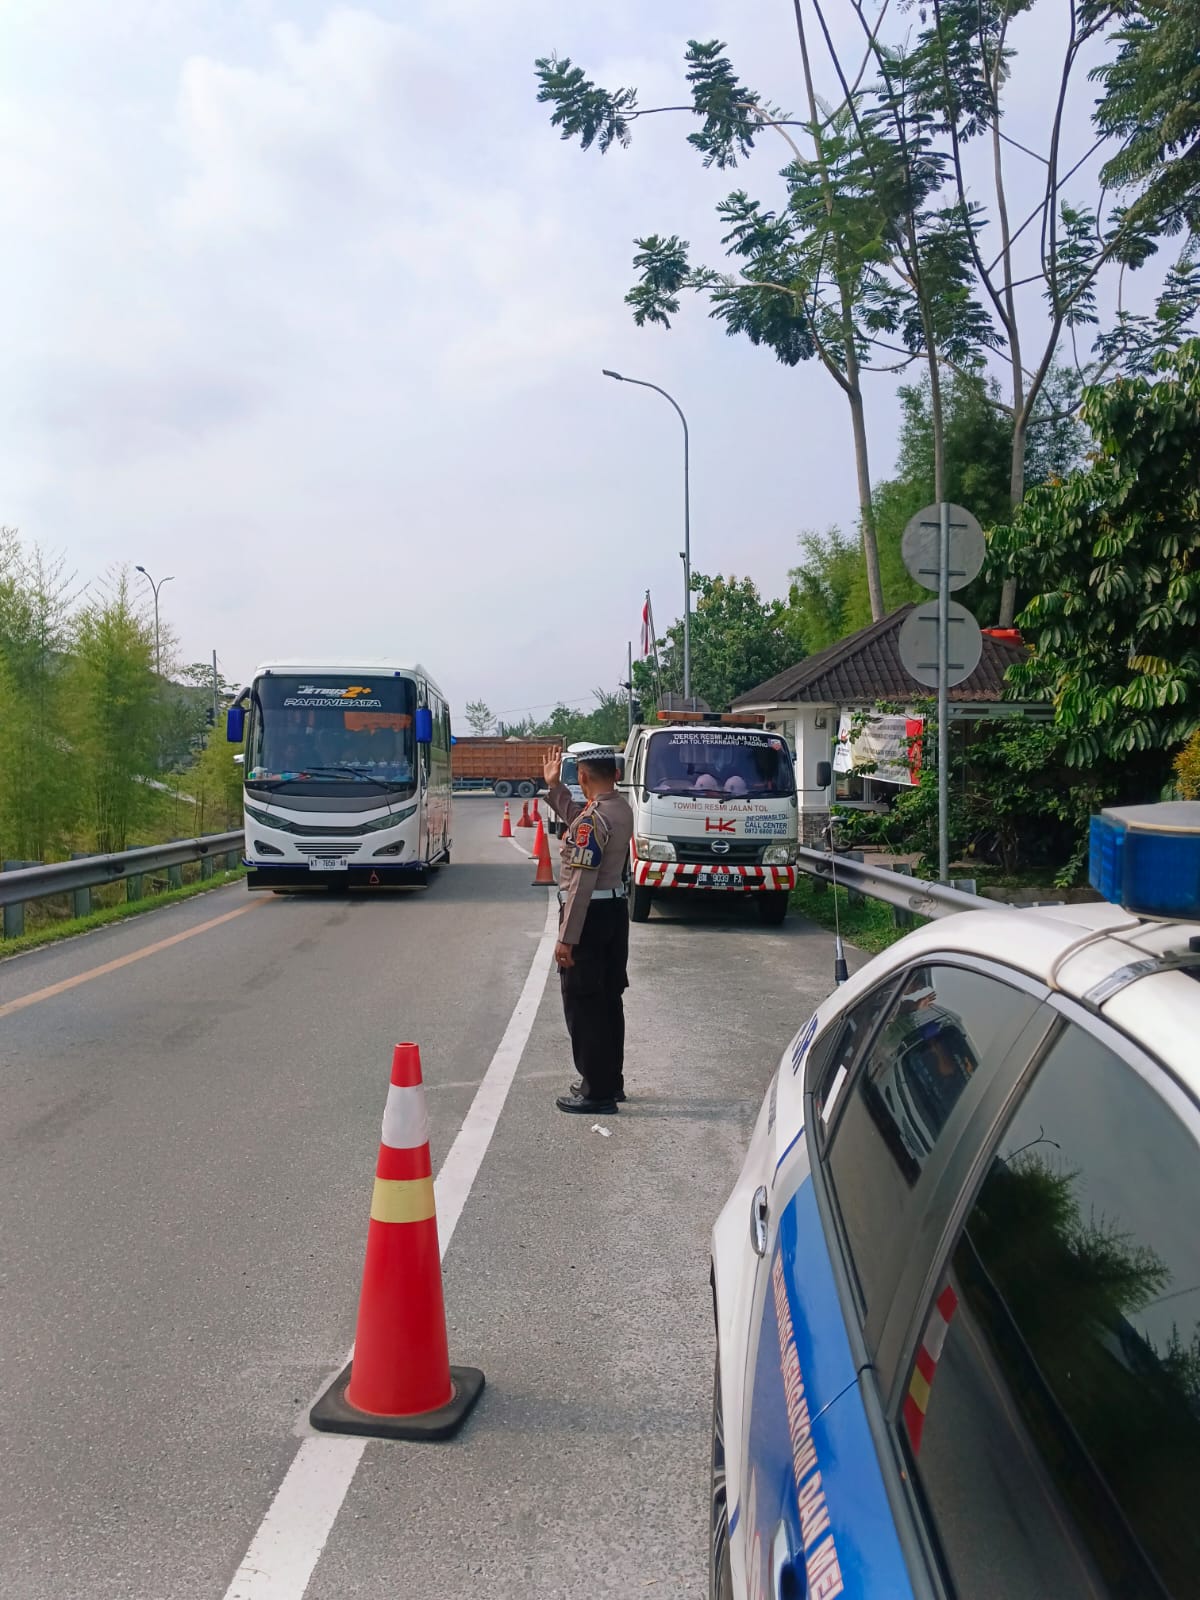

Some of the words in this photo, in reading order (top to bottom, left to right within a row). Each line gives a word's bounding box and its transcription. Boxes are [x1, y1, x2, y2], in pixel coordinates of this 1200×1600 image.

[284, 698, 382, 707] PARIWISATA
[744, 740, 768, 748] PADANG
[673, 801, 702, 810] TOWING
[704, 803, 727, 811] RESMI
[729, 803, 753, 812] JALAN
[754, 804, 769, 812] TOL
[705, 816, 736, 832] HK
[798, 1470, 830, 1552] DAN
